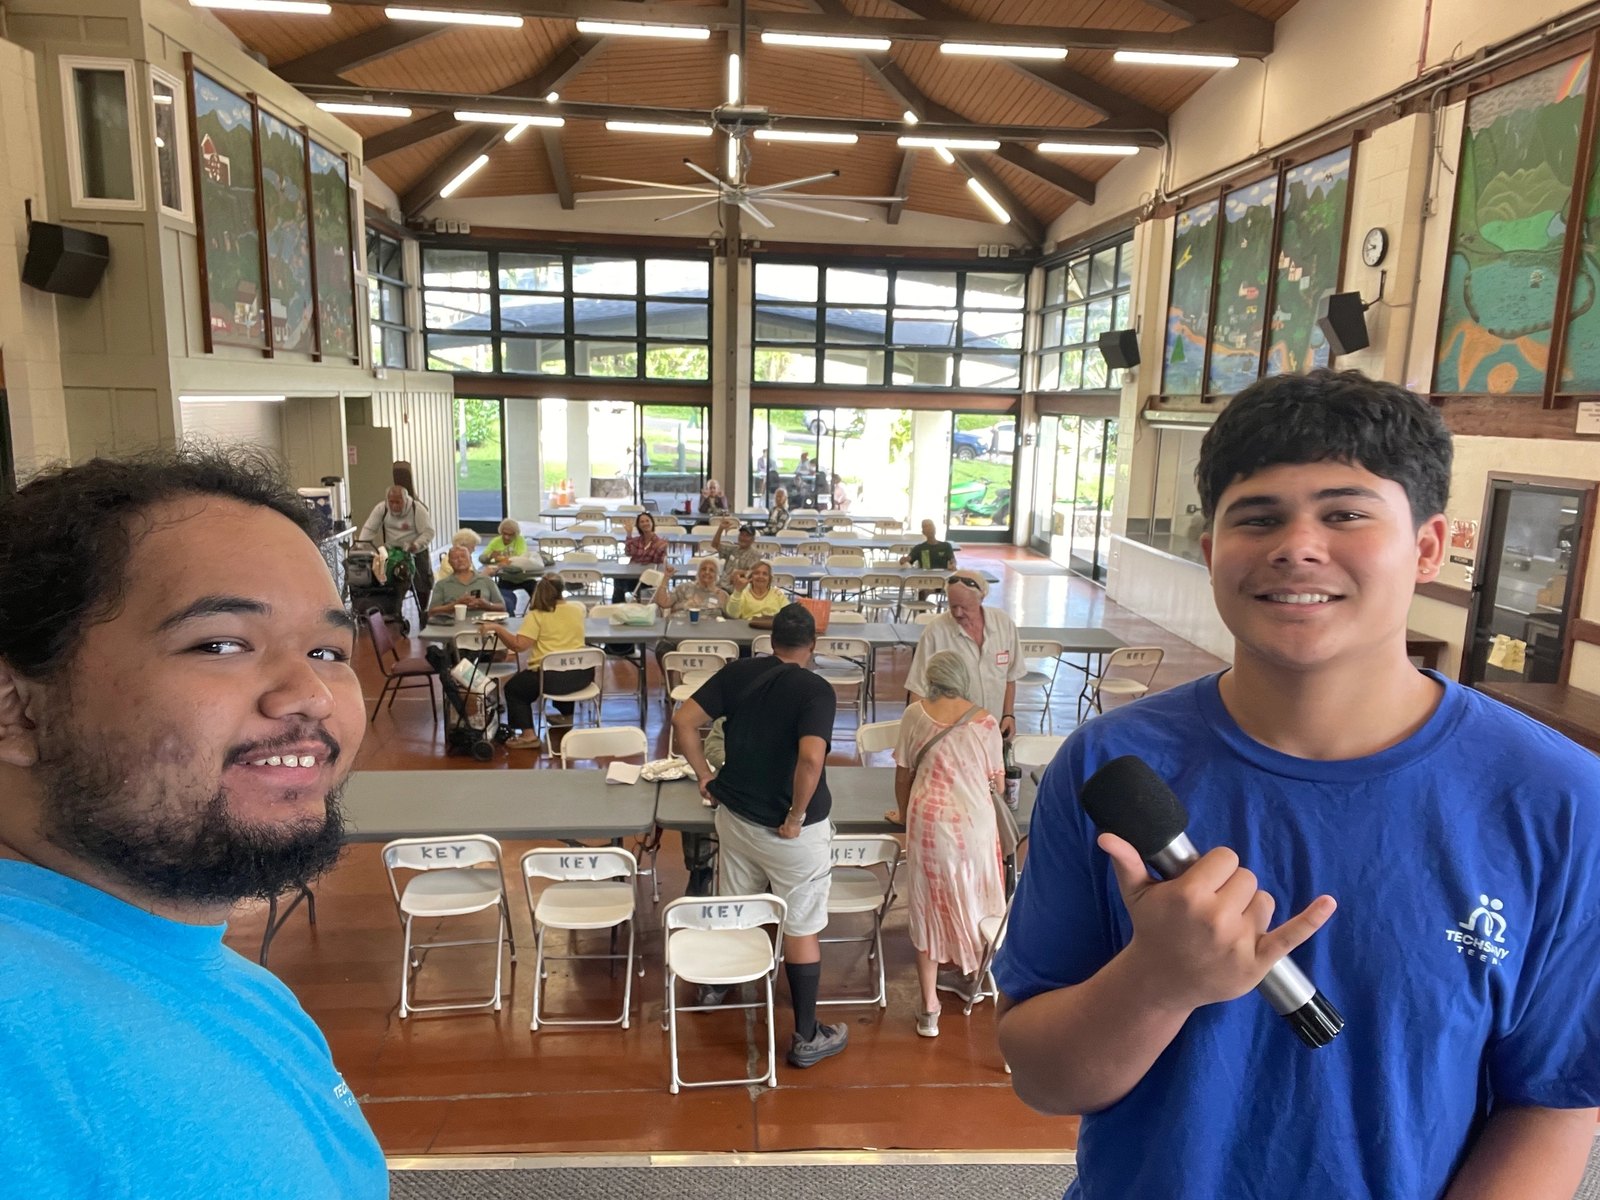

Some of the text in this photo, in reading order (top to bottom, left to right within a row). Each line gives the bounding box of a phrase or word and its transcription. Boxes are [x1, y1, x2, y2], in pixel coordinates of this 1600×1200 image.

[697, 645, 718, 653] KEY
[830, 642, 850, 650] KEY
[560, 656, 584, 666] KEY
[683, 659, 704, 667] KEY
[421, 846, 466, 859] KEY
[831, 848, 866, 859] KEY
[560, 856, 599, 869] KEY
[701, 904, 744, 918] KEY
